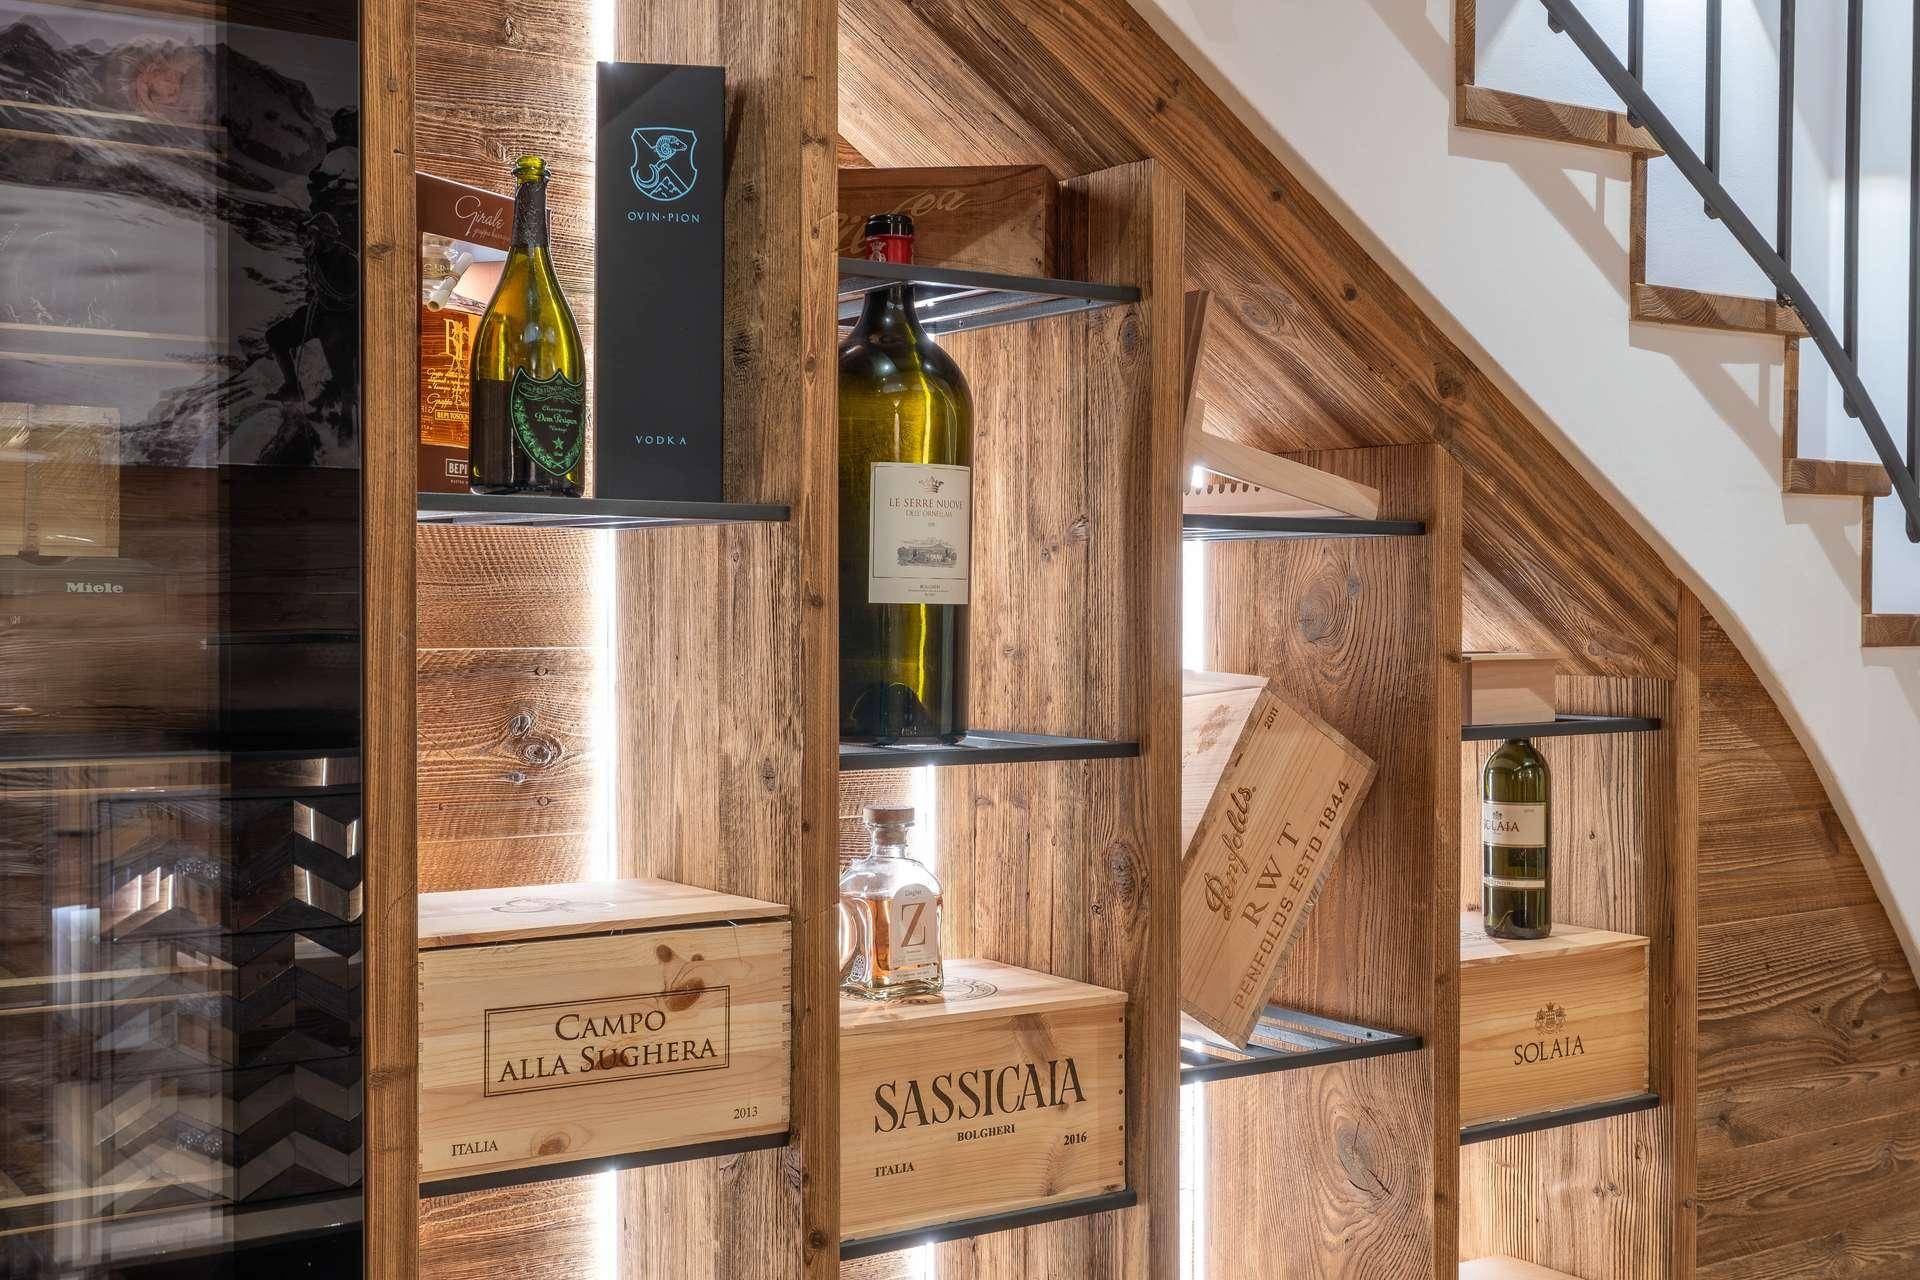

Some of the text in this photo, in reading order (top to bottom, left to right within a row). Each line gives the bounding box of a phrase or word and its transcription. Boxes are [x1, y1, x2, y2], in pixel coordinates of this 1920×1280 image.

[635, 435, 687, 445] VODKA
[889, 498, 963, 510] LE SERRE NUOVE
[66, 582, 124, 594] Miele
[1264, 706, 1279, 730] 2011
[1204, 786, 1253, 921] Penfolds
[1232, 896, 1294, 1010] PENFOLDS
[1289, 835, 1323, 894] ESTD
[1318, 778, 1351, 831] 1844
[555, 1008, 667, 1042] CAMPO
[1513, 1034, 1585, 1066] SOLAIA
[497, 1038, 718, 1083] ALLA SUGHERA
[873, 1056, 1088, 1134] SASSICAIA
[732, 1106, 759, 1120] 2013
[956, 1123, 1016, 1142] BOLGHERI
[1063, 1131, 1088, 1146] 2016
[451, 1139, 499, 1157] ITALIA
[873, 1161, 915, 1178] ITALIA
